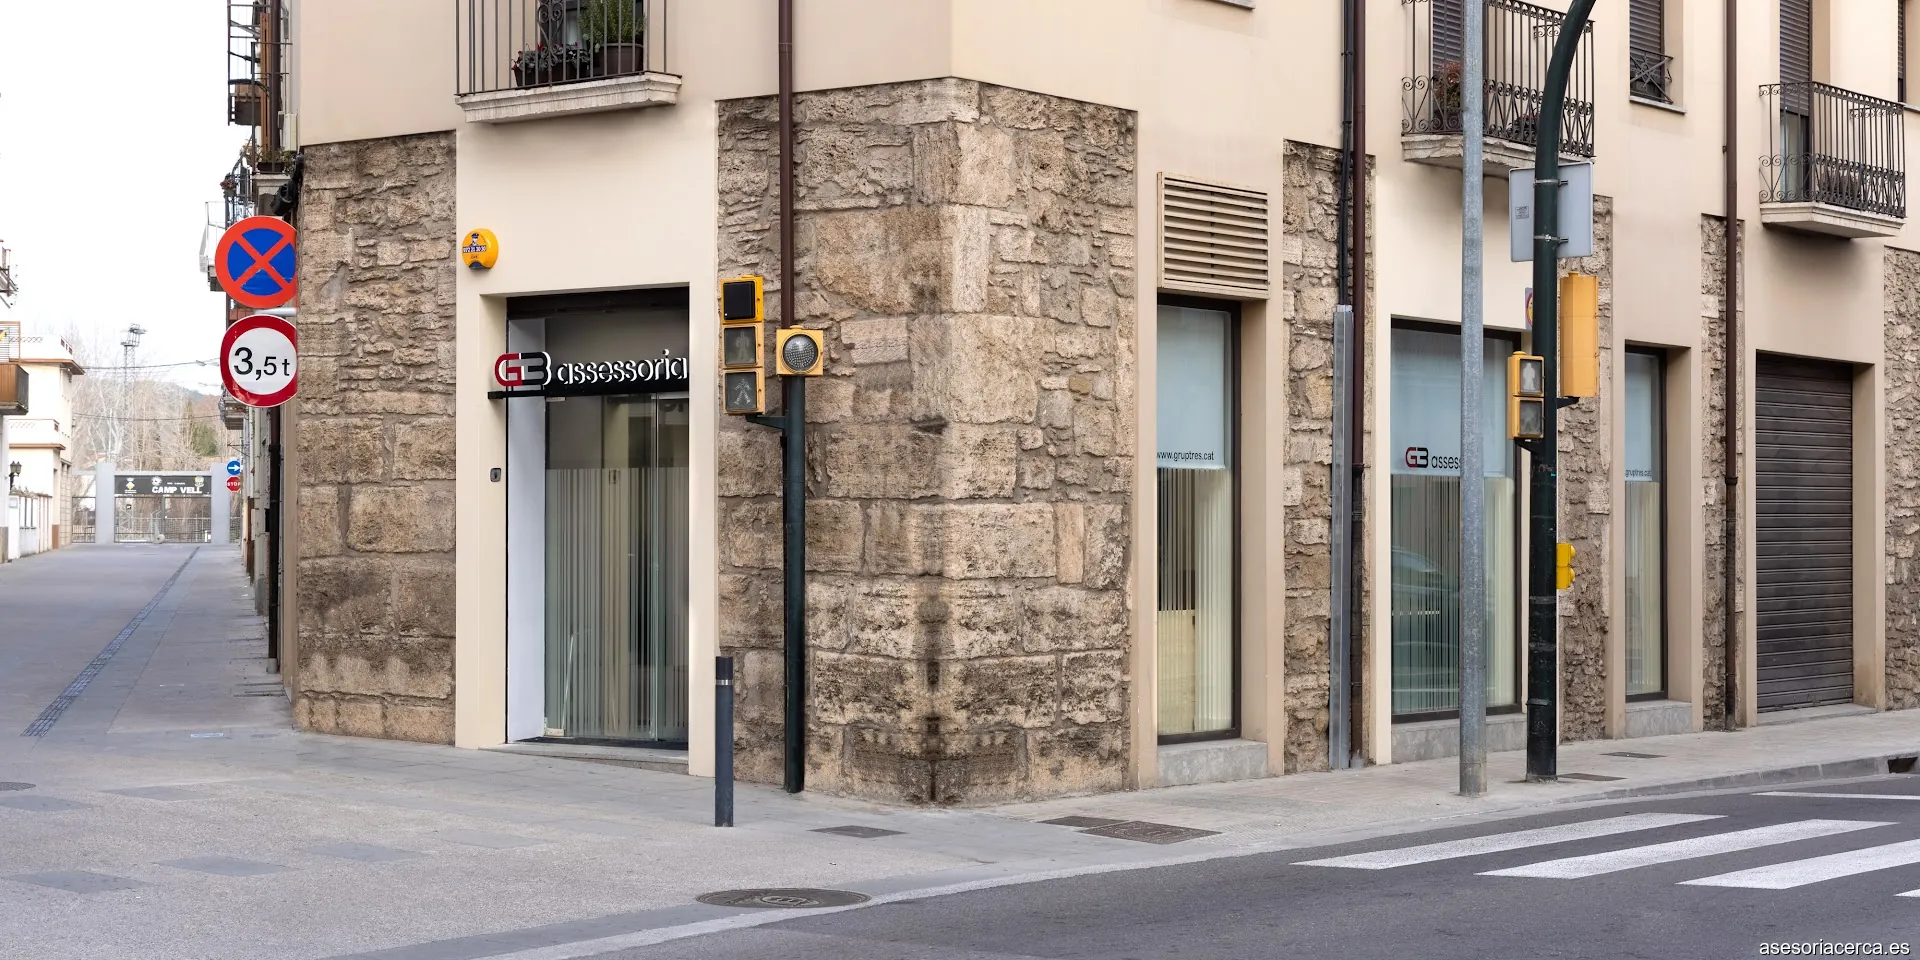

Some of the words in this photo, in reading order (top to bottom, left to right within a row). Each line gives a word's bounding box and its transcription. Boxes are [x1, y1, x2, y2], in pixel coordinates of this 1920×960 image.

[234, 347, 277, 380] 3,5
[282, 358, 290, 376] t
[557, 349, 688, 385] assessoria
[1431, 456, 1462, 470] asses
